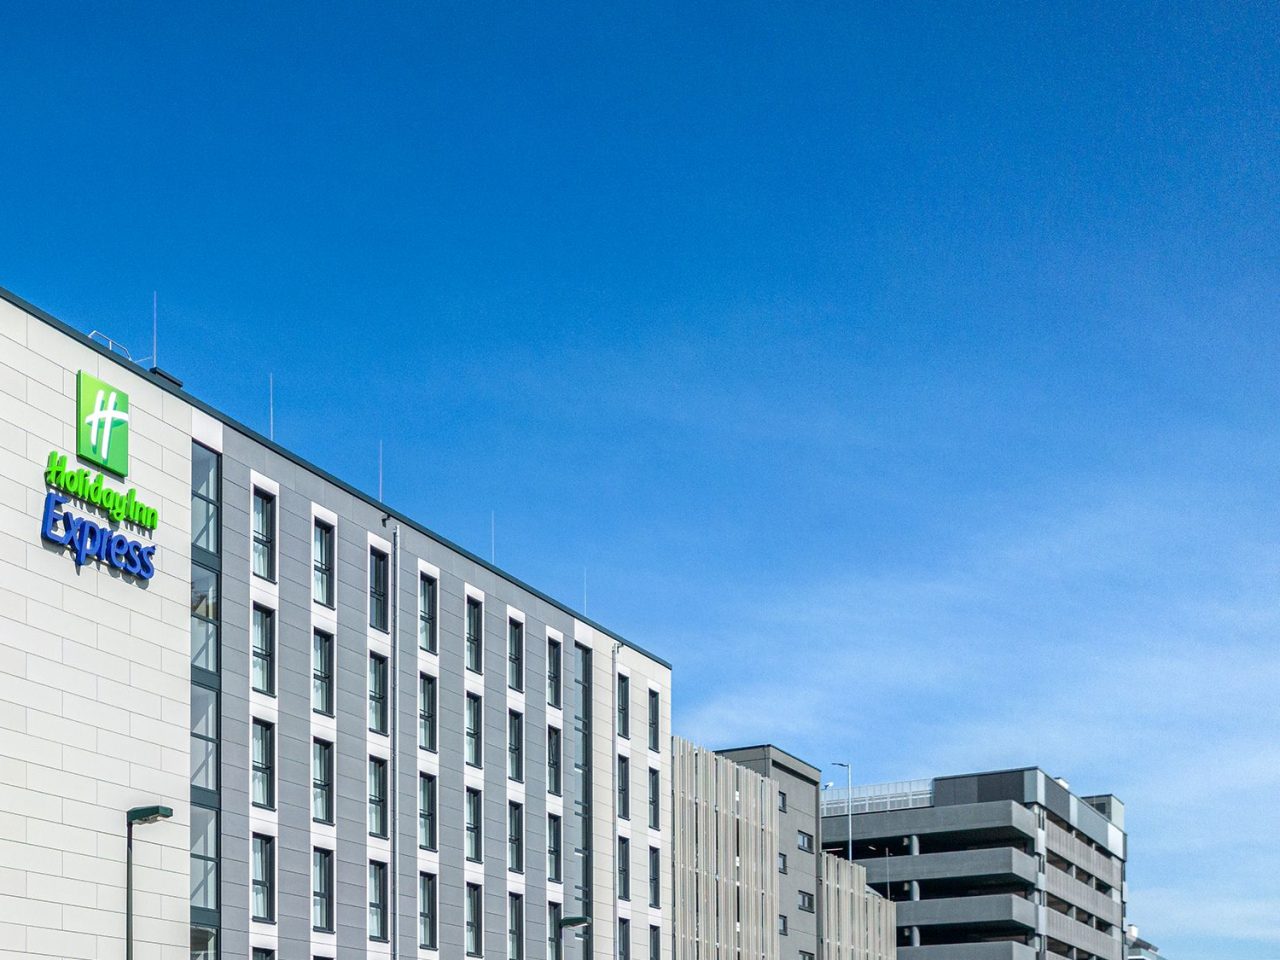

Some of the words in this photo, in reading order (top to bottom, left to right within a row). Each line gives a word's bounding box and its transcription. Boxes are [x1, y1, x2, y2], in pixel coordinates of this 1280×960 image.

[45, 450, 126, 522] Holiday
[126, 488, 158, 530] Inn
[40, 491, 156, 580] Express
